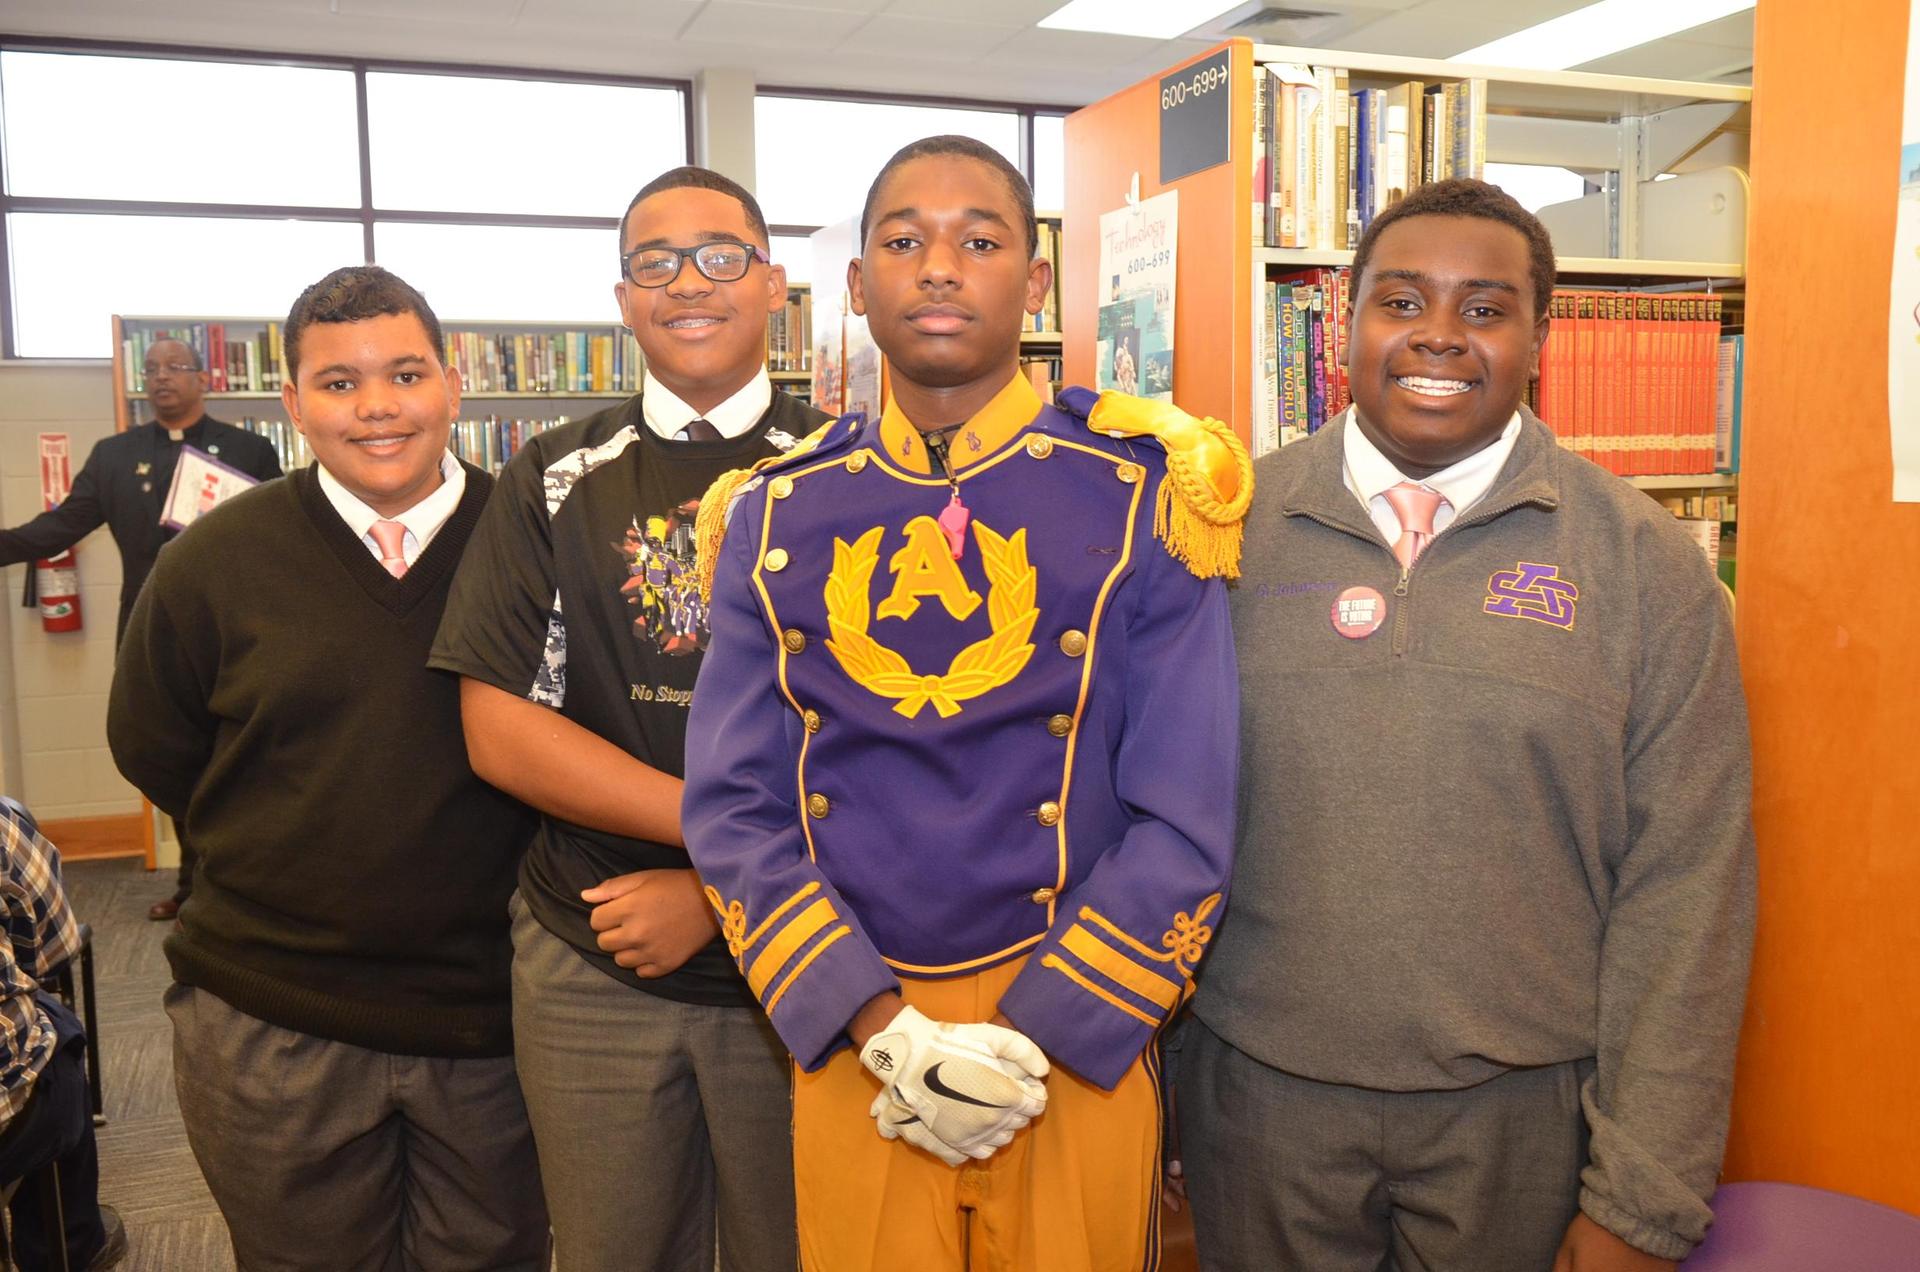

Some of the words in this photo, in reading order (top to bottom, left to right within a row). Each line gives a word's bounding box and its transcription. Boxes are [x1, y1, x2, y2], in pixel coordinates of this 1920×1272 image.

[1105, 213, 1166, 264] Technology
[1283, 303, 1294, 338] HOW
[876, 515, 983, 621] A
[1338, 600, 1351, 611] THE
[1351, 598, 1377, 611] FUTURE
[630, 684, 653, 701] No
